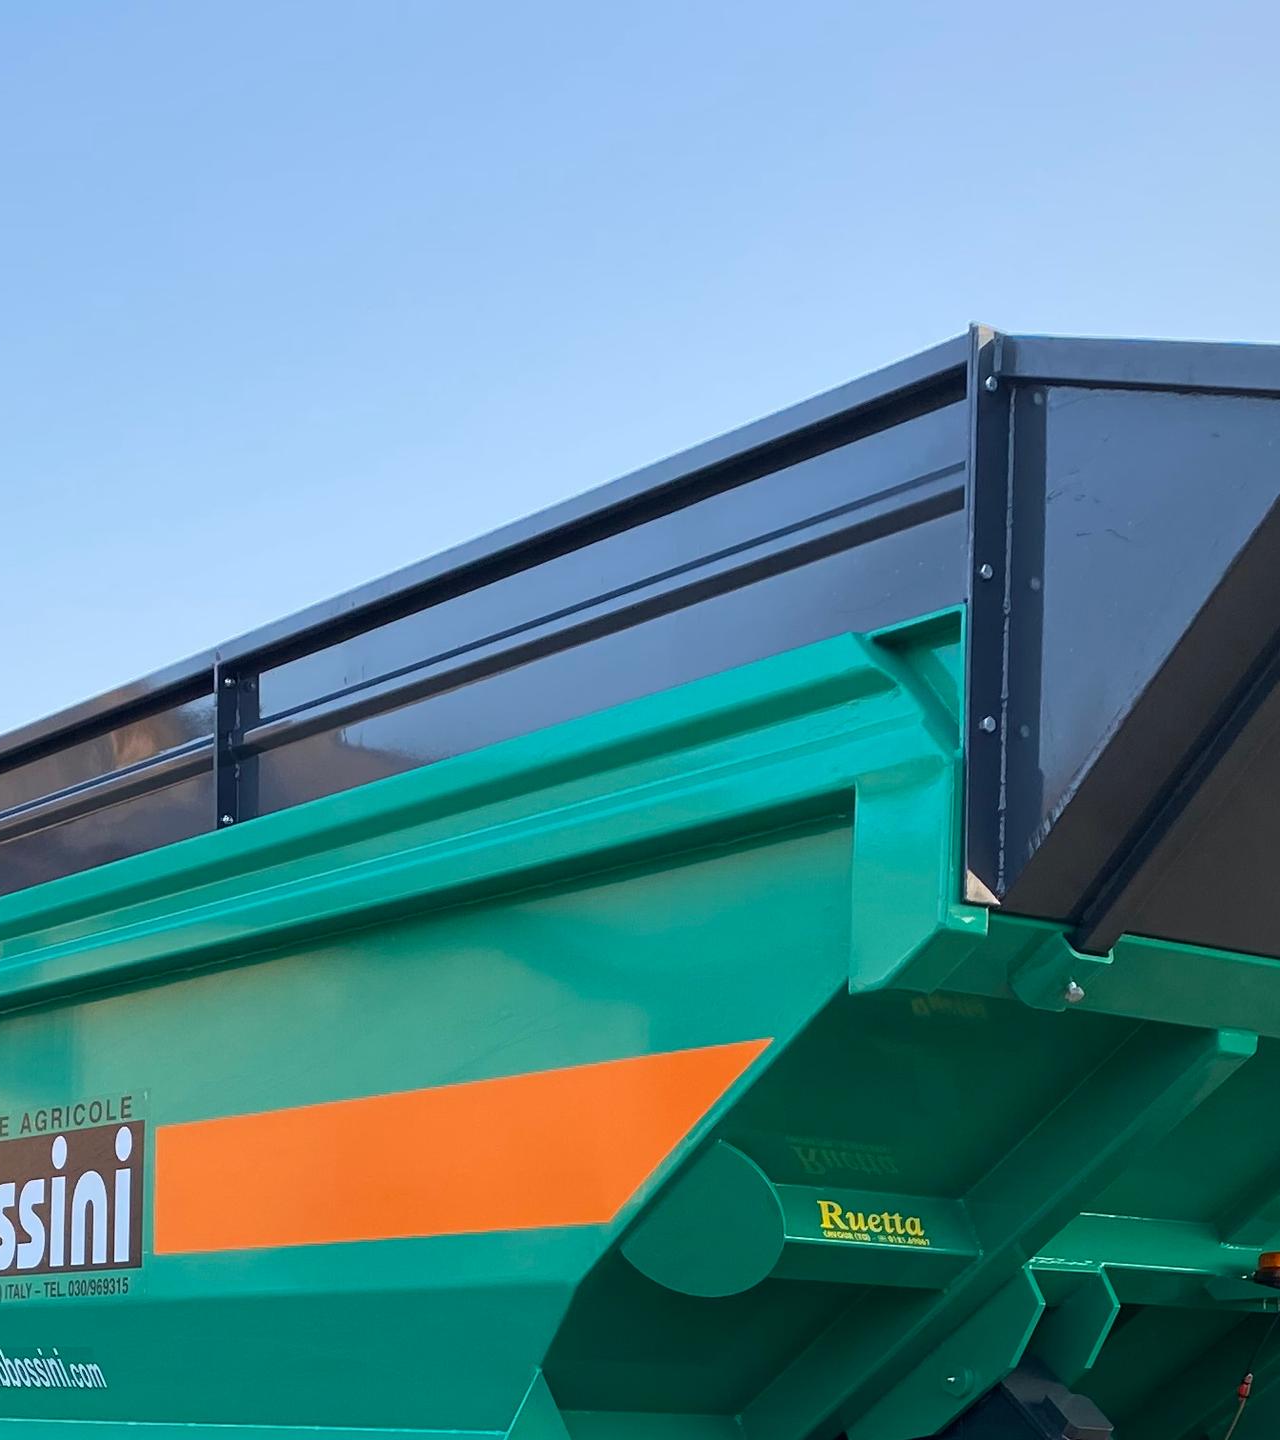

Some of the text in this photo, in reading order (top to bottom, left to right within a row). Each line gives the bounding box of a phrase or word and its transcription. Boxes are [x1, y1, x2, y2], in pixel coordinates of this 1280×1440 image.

[20, 1096, 133, 1134] AGRICOLE
[816, 1199, 925, 1236] Ruetta
[5, 1282, 33, 1300] ITALY
[44, 1281, 66, 1298] TEL.
[68, 1277, 129, 1297] 030/969315
